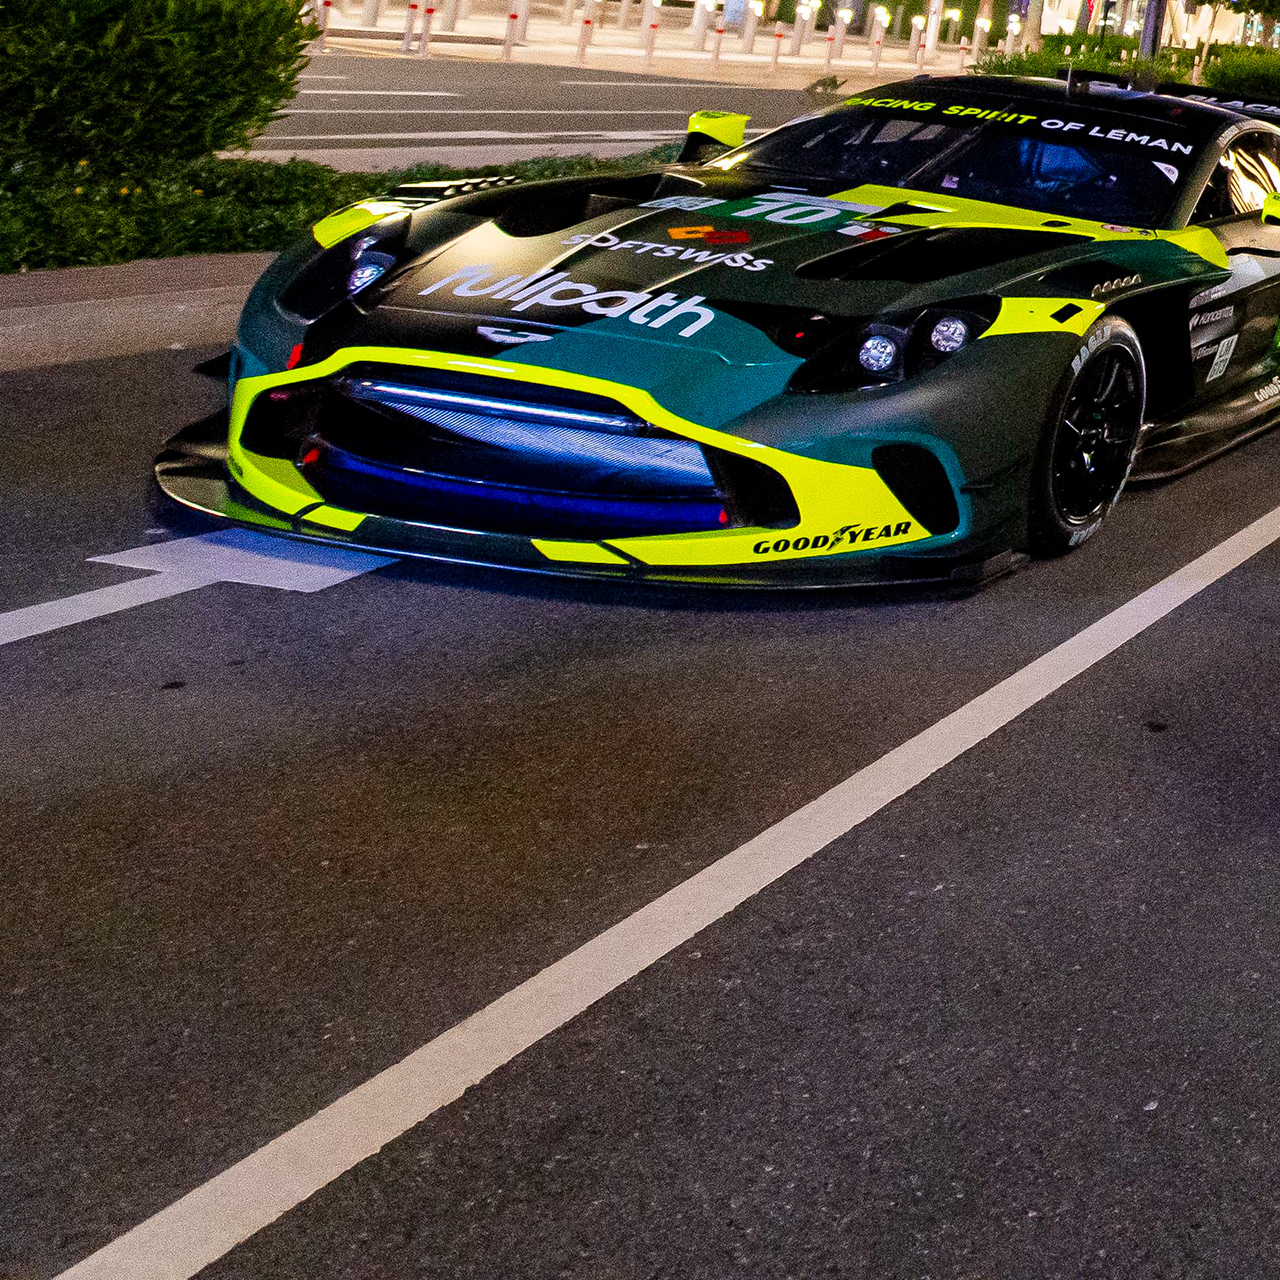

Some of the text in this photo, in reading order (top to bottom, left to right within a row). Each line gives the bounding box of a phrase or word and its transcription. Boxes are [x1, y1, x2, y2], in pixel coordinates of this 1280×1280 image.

[844, 97, 937, 112] RACING
[1041, 119, 1086, 132] OF
[730, 200, 842, 225] 10
[561, 230, 775, 272] SOFTSWISS
[417, 263, 716, 338] fullpath
[752, 521, 912, 556] GOODYEAR
